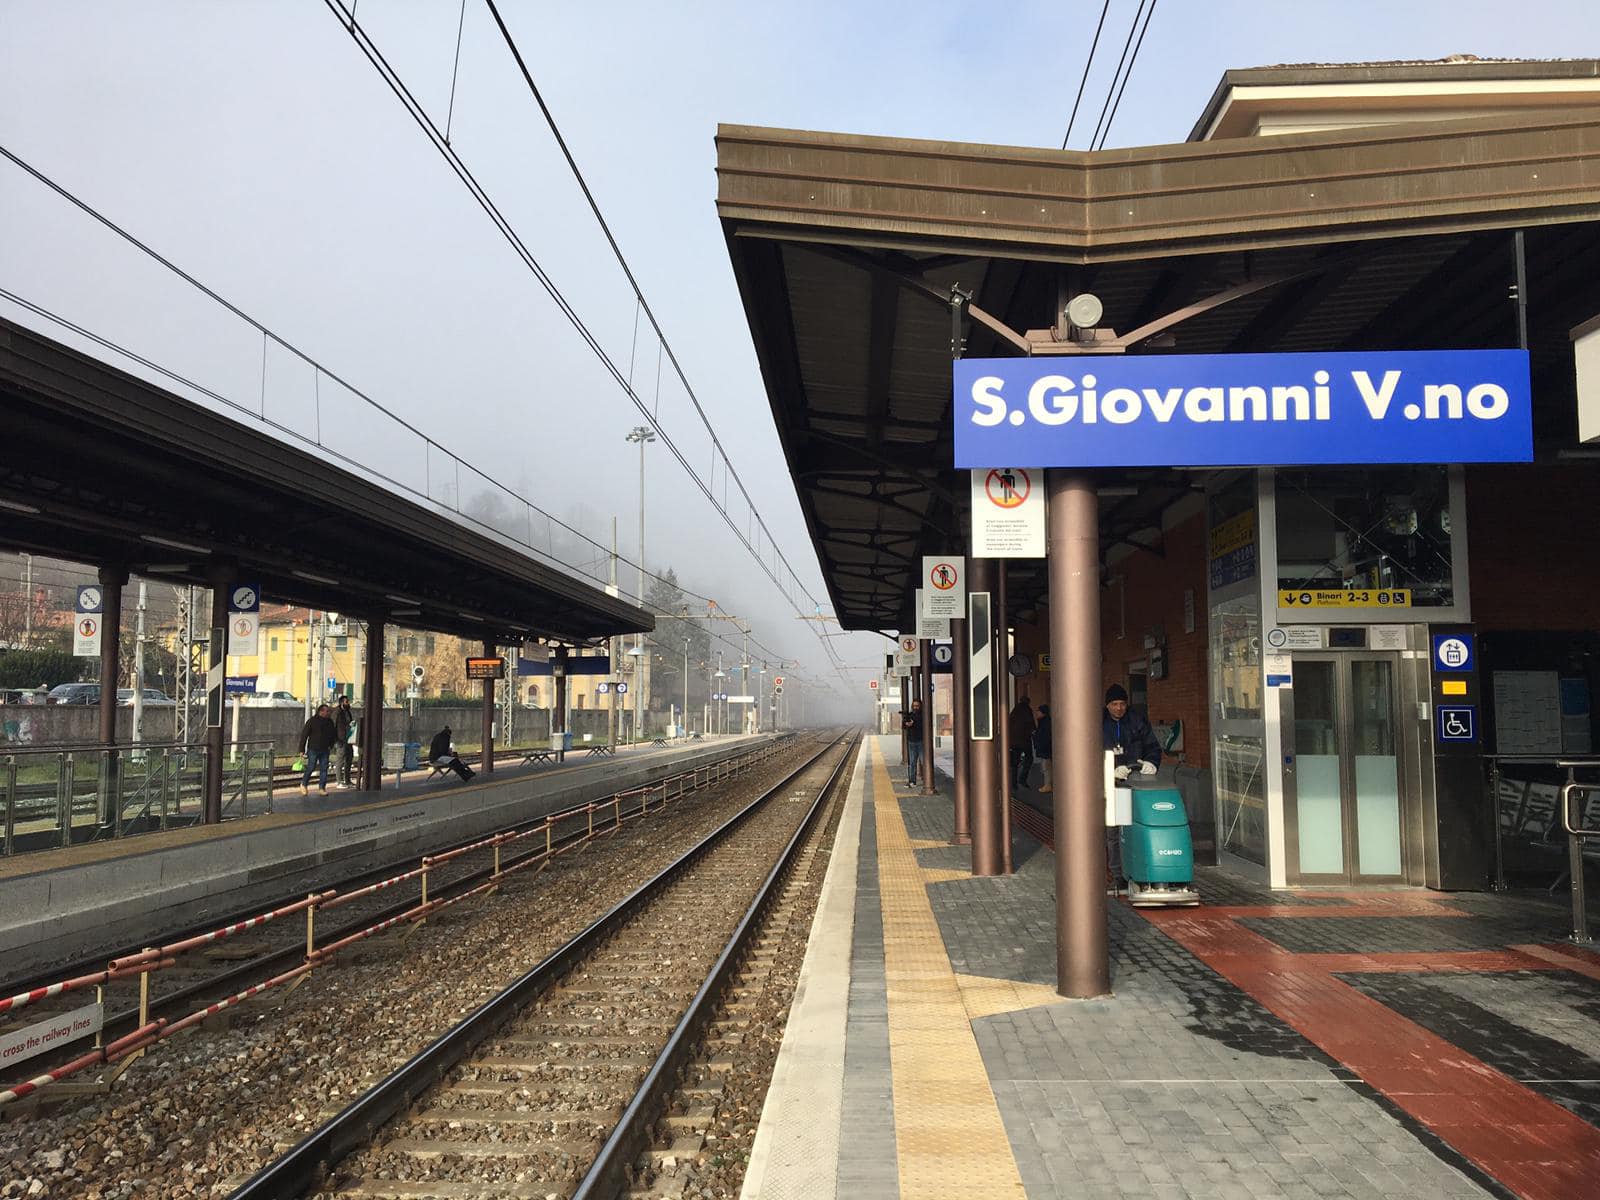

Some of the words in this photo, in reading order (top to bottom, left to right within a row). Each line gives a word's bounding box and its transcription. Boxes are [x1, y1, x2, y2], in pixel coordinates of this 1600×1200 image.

[970, 370, 1331, 427] S.Giovanni
[1351, 370, 1510, 420] V.no
[1316, 591, 1342, 600] Binari
[1347, 592, 1369, 602] 2-3
[2, 1043, 26, 1058] cross
[26, 1037, 40, 1048] the
[42, 1026, 71, 1043] railway
[73, 1018, 91, 1032] lines
